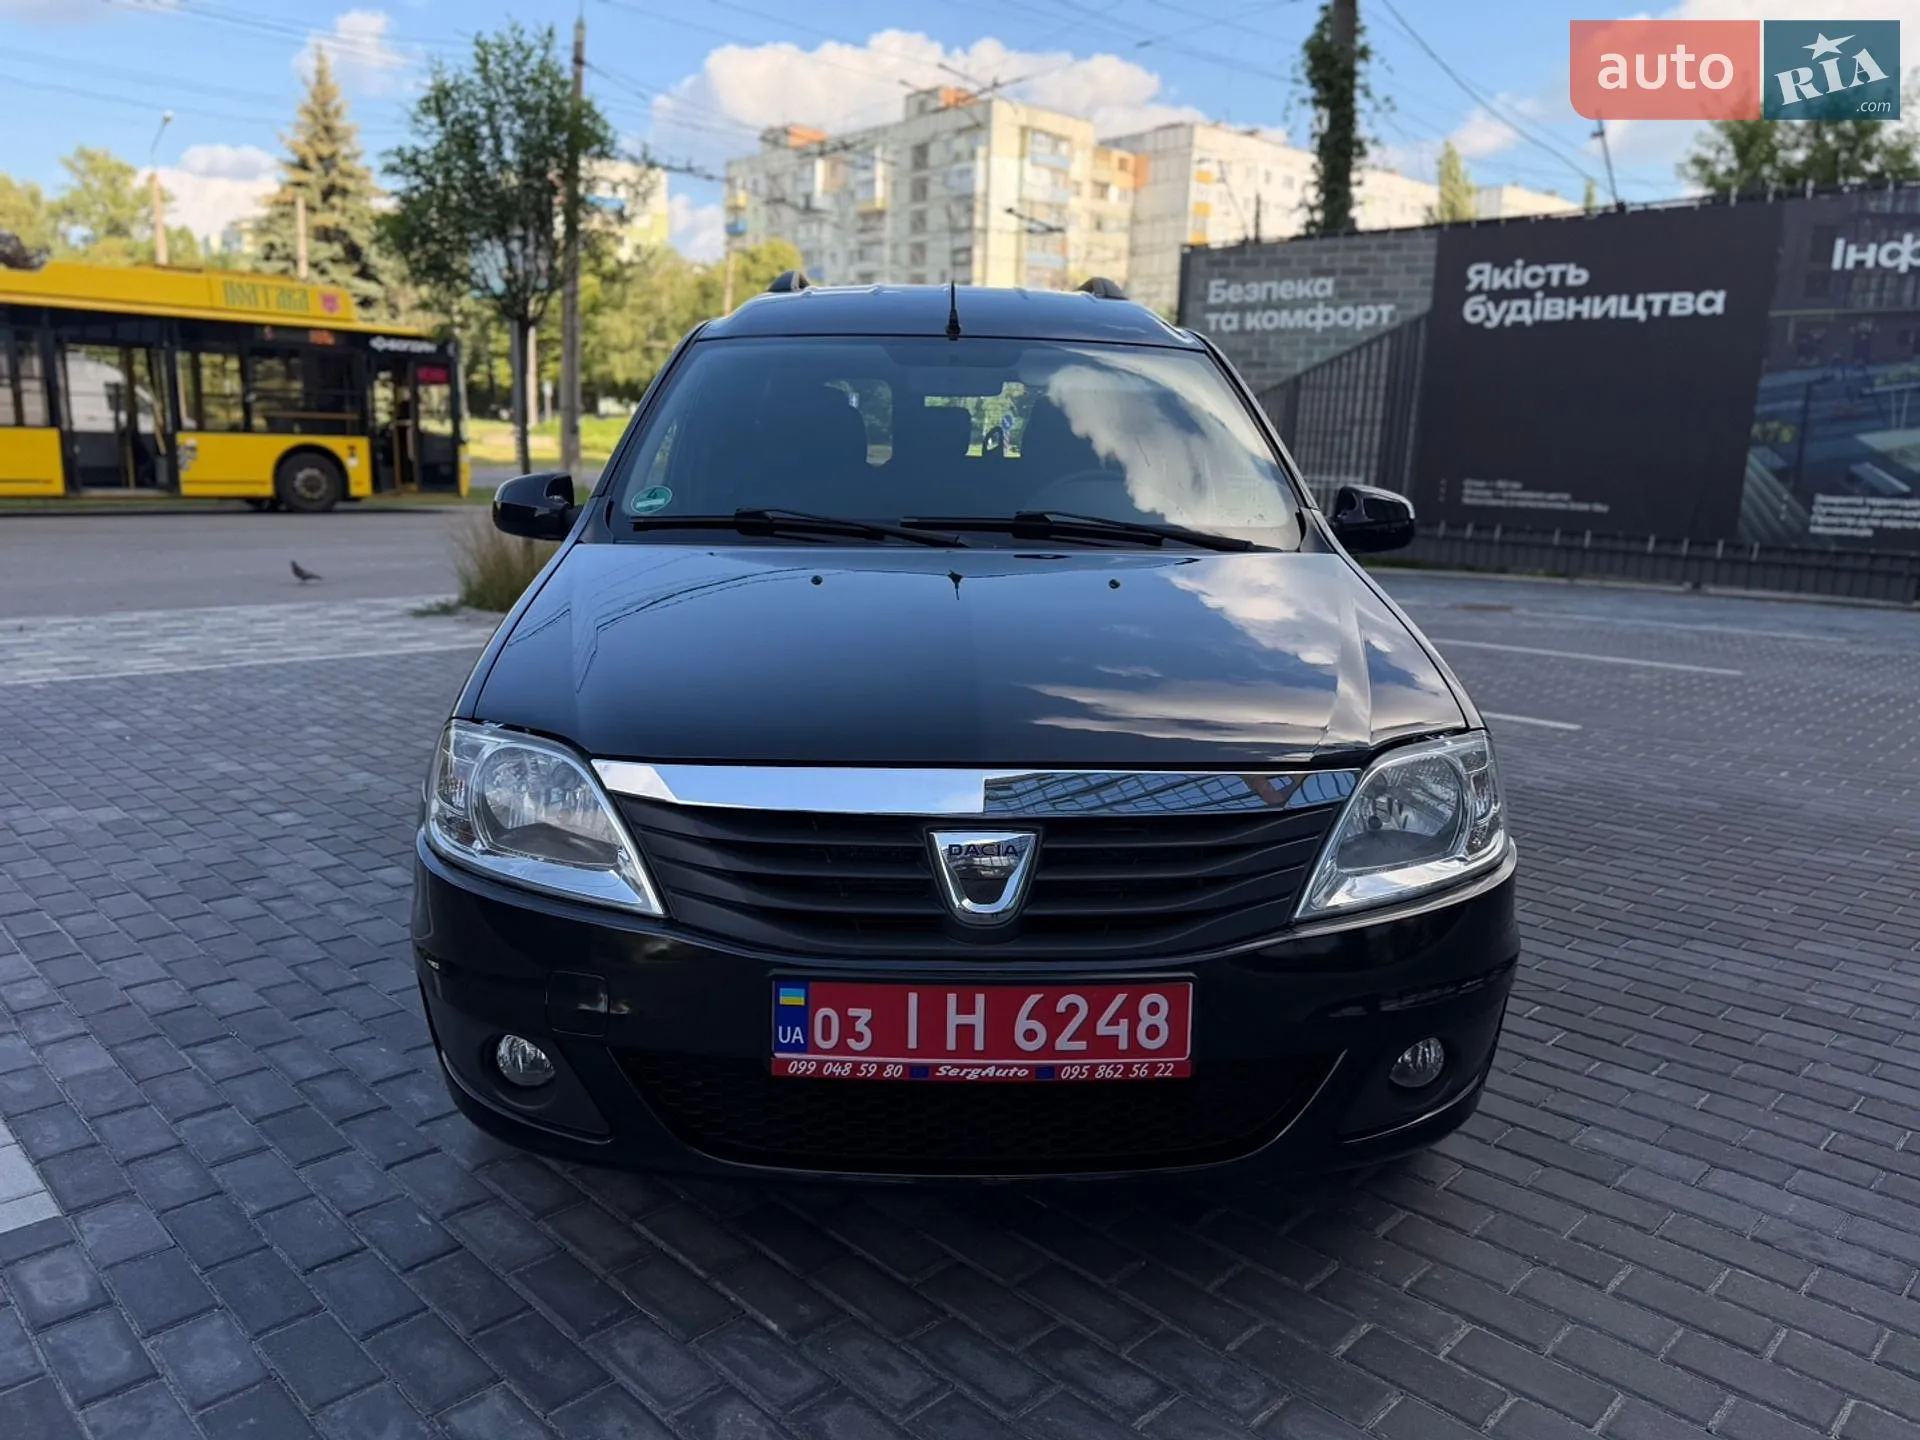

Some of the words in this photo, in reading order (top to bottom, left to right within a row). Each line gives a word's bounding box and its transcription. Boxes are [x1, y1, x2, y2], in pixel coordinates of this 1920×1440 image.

[1464, 258, 1590, 292] Якість
[1207, 276, 1335, 304] Безпека
[1205, 311, 1240, 332] та
[1245, 302, 1396, 333] комфорт
[1462, 289, 1727, 329] будівництва
[948, 843, 1019, 857] DACIA
[813, 1007, 873, 1052] 03
[1013, 992, 1170, 1052] 6248
[778, 1026, 804, 1044] UA
[787, 1060, 815, 1075] 099
[822, 1062, 851, 1076] 048
[856, 1063, 877, 1077] 59
[882, 1064, 903, 1078] 80
[936, 1065, 1028, 1080] SergAuto
[1060, 1064, 1090, 1080] 095
[1094, 1063, 1123, 1079] 862
[1129, 1063, 1148, 1078] 56
[1154, 1062, 1174, 1077] 22
